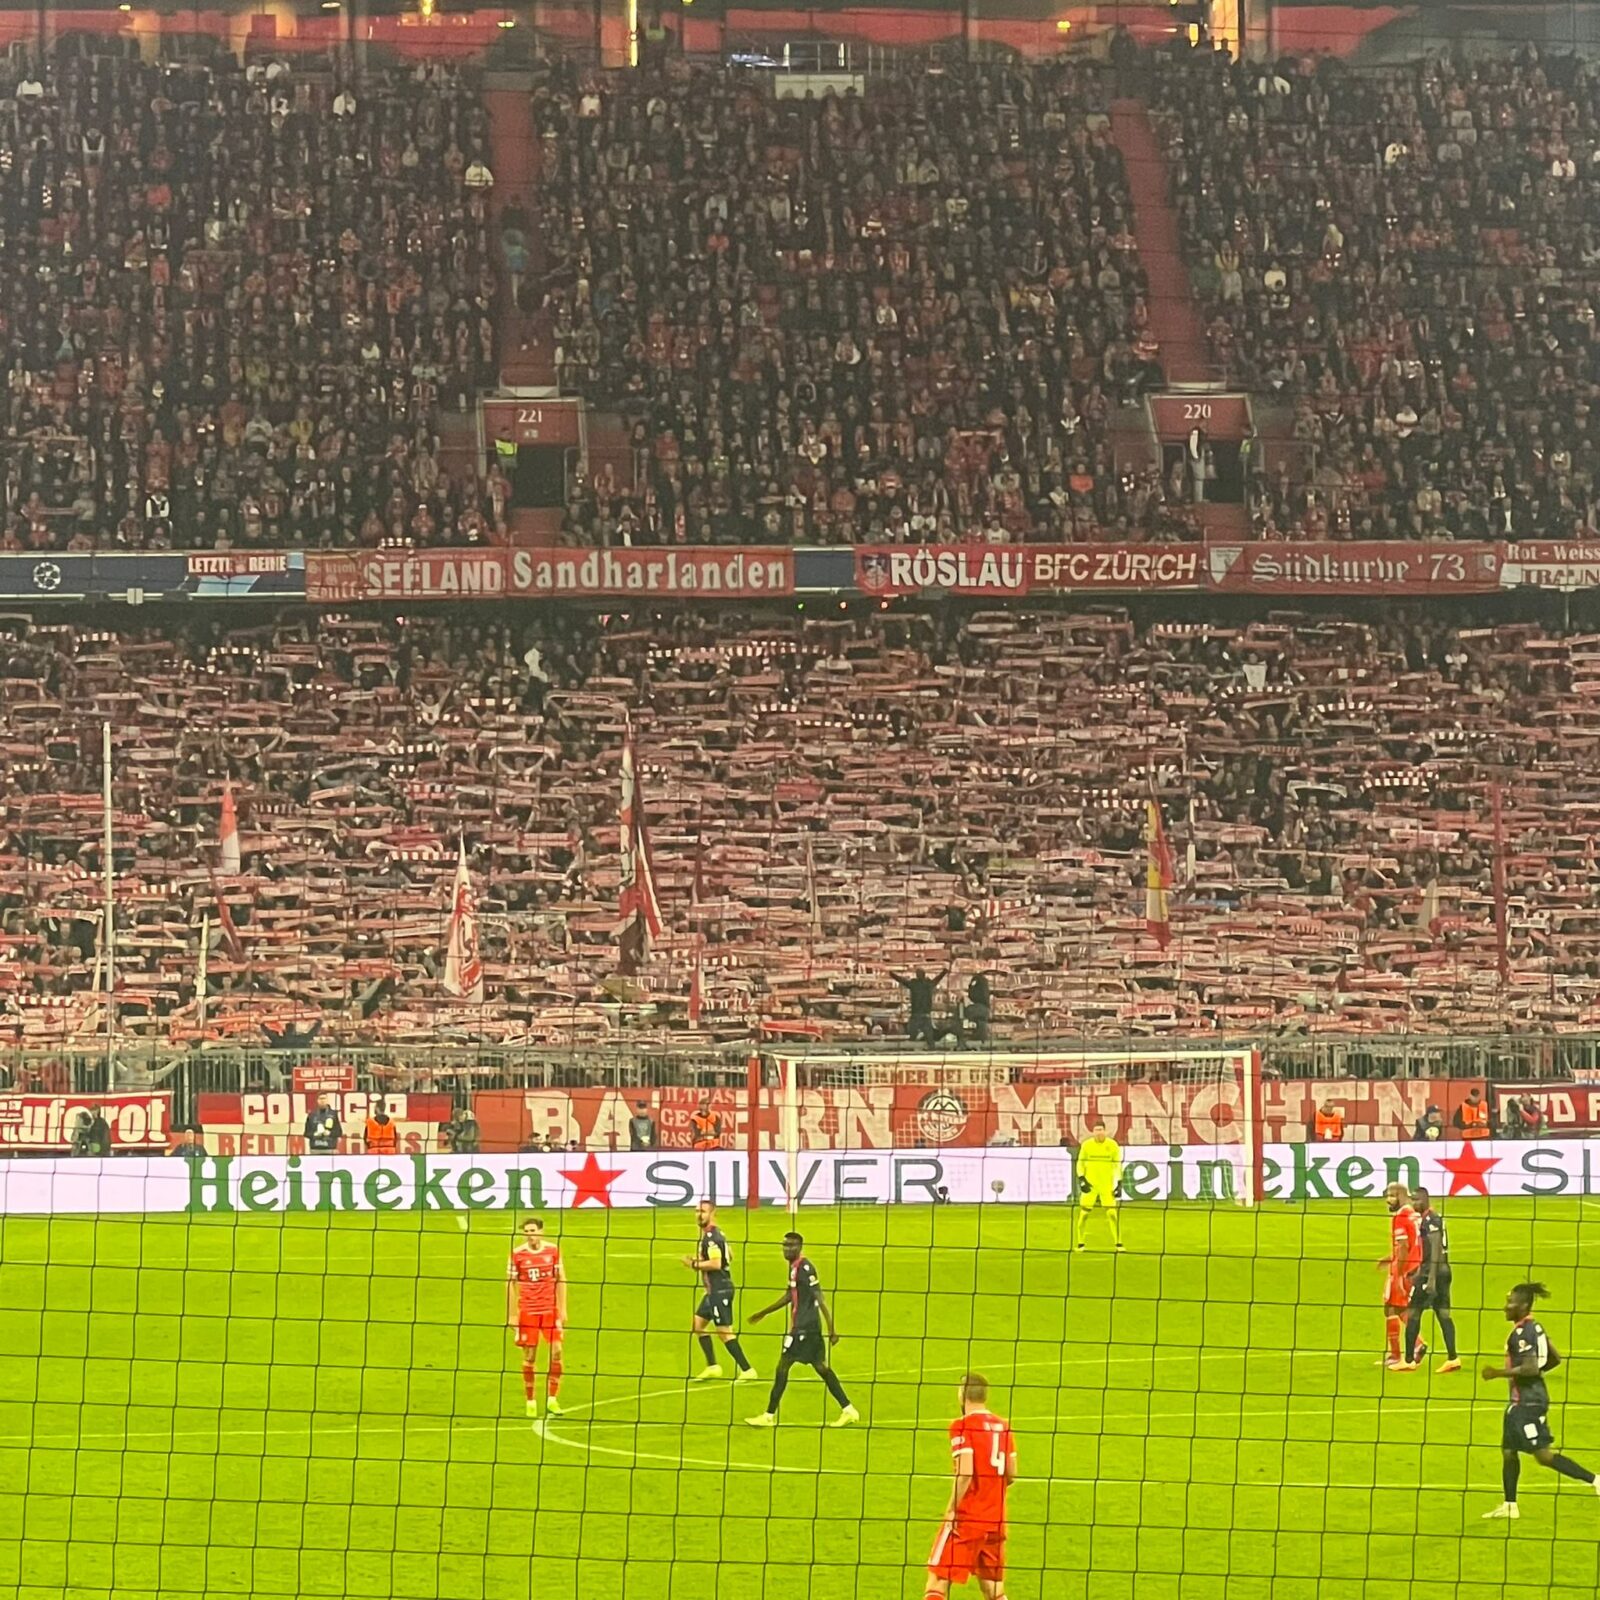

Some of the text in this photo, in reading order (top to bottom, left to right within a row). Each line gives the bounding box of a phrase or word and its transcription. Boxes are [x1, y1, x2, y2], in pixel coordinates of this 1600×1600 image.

[518, 409, 542, 423] 221
[1184, 404, 1212, 419] 220
[364, 561, 501, 596] SEELAND
[513, 551, 785, 590] Sandharlanden
[890, 549, 1023, 588] RÖSLAU
[1034, 550, 1196, 582] BFC ZÜRICH
[1251, 553, 1465, 584] Südkurve '73
[525, 1088, 893, 1149] BAERN
[184, 1154, 548, 1212] Heineken
[644, 1160, 944, 1207] SILVER
[1066, 1143, 1421, 1202] eineken
[990, 1432, 1006, 1476] 4
